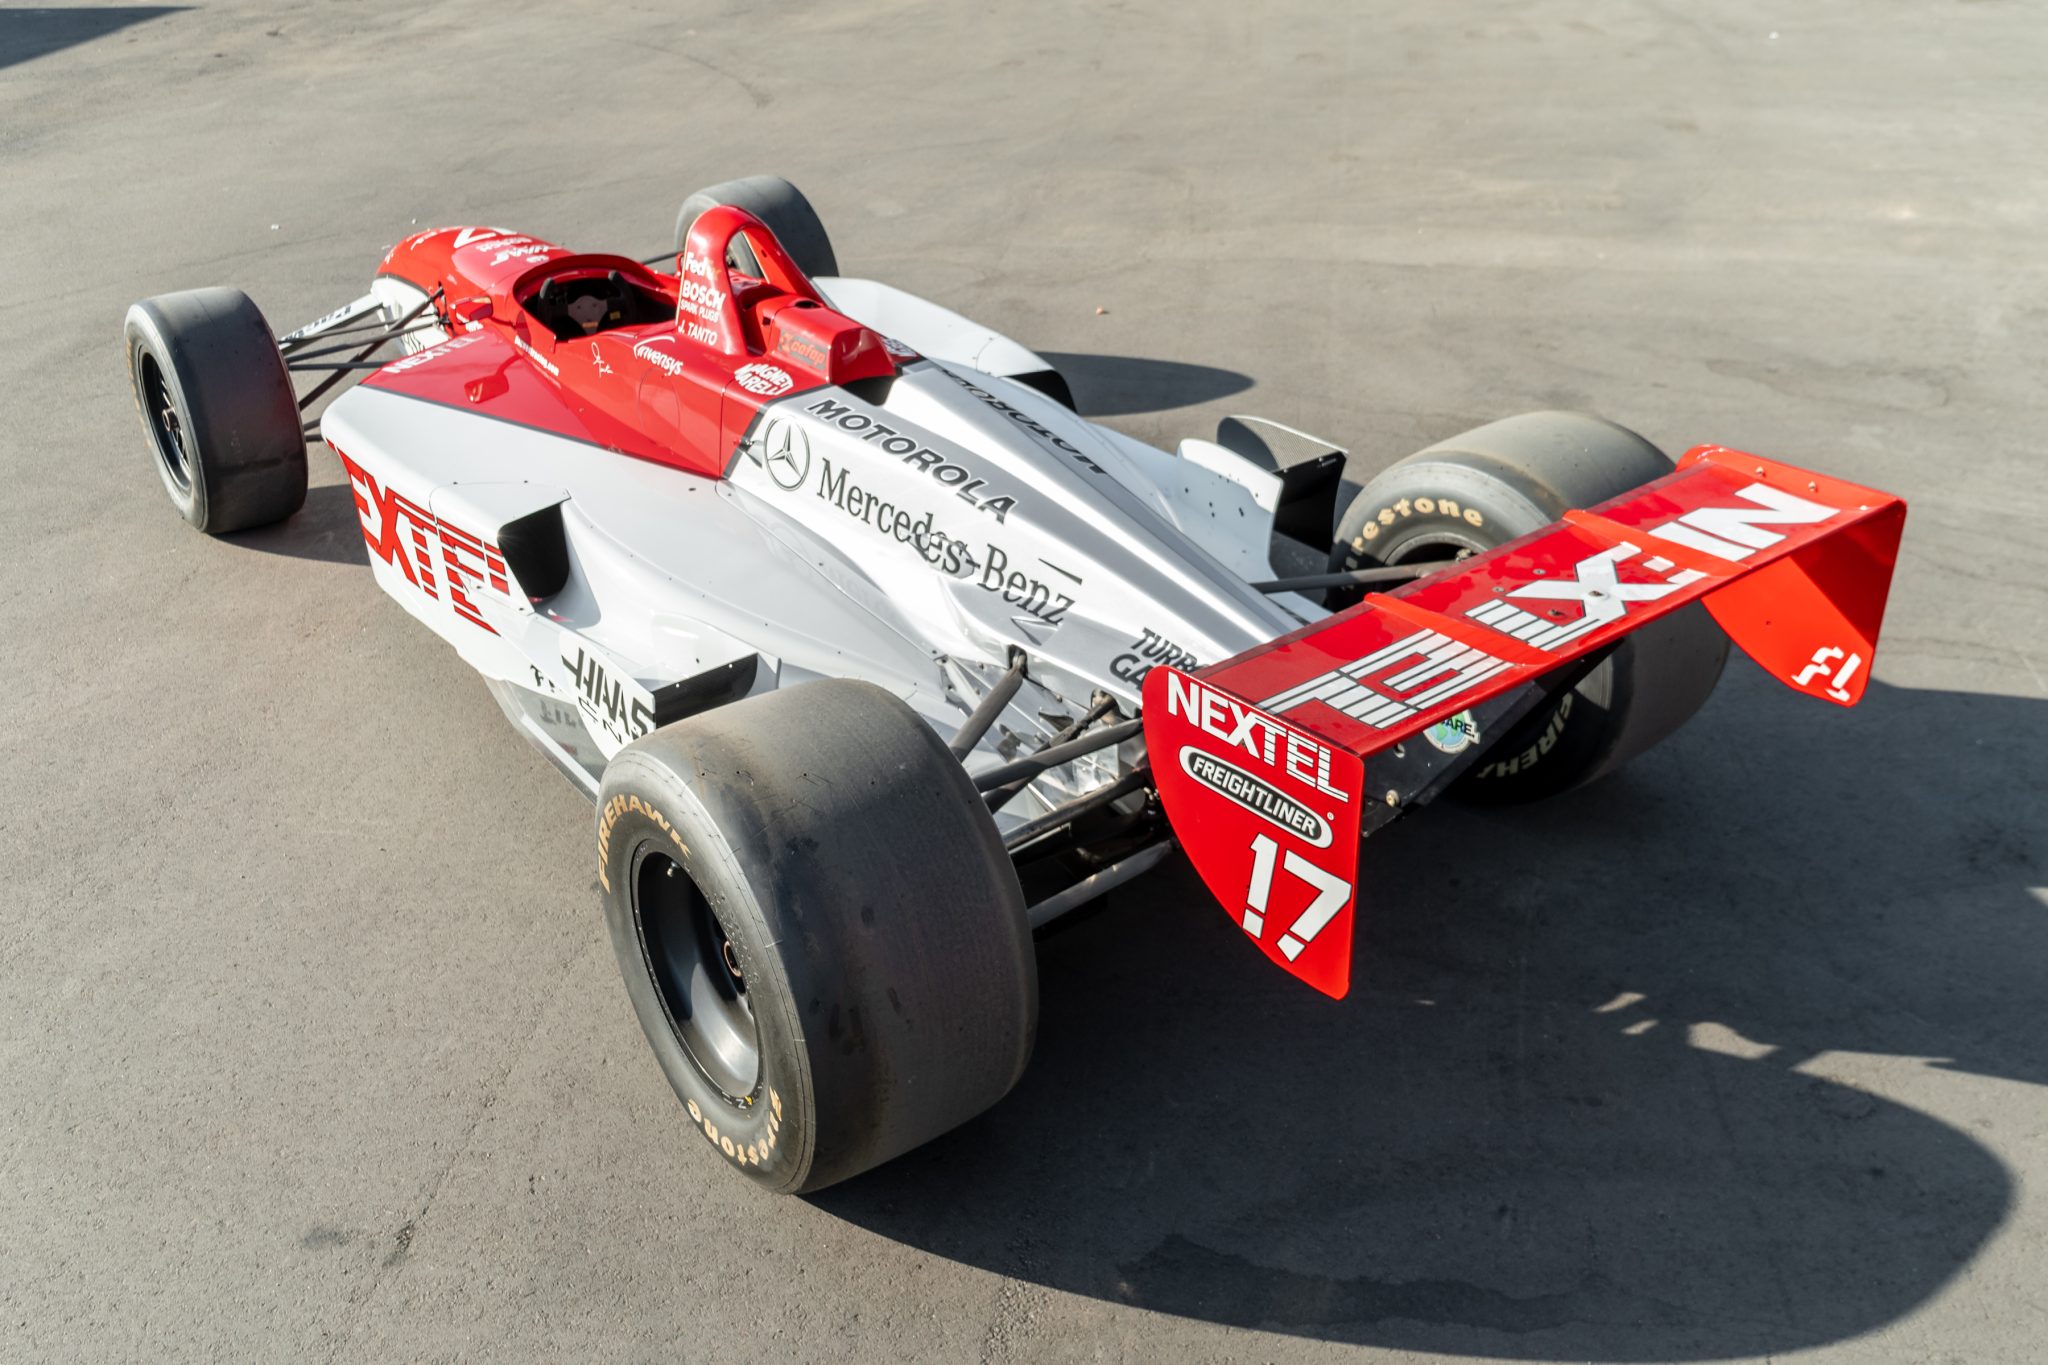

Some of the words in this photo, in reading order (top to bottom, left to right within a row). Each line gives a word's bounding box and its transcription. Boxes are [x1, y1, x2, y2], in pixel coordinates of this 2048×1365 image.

[678, 319, 685, 334] J.
[687, 321, 718, 346] TANTO
[682, 280, 727, 311] BOSCH
[382, 335, 486, 374] NEXTEL
[635, 338, 684, 377] invensys
[807, 398, 1018, 525] MOTOROLA
[816, 457, 1076, 627] Mercedes-Benz
[1131, 627, 1209, 673] TURB
[1167, 671, 1349, 803] NEXTEL
[1192, 753, 1318, 838] FREIGHTLINER
[597, 792, 692, 894] FIREHAWK
[1242, 832, 1353, 964] 17
[687, 1085, 784, 1167] Firestone
